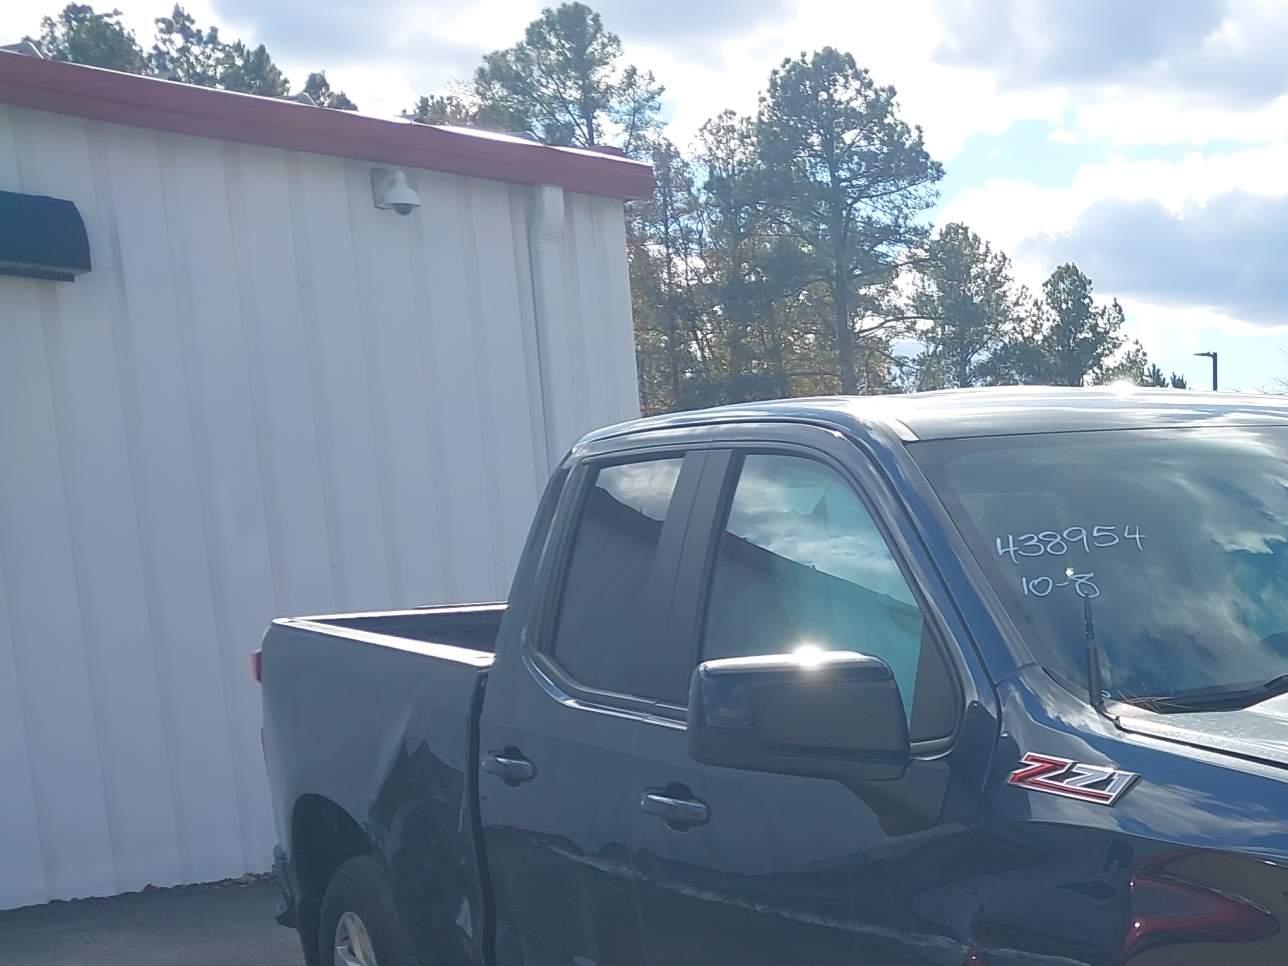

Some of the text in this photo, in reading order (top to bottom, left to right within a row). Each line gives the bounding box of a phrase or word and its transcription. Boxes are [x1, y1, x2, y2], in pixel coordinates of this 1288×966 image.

[996, 524, 1146, 564] 438954
[1021, 572, 1100, 598] 10-8
[1008, 751, 1137, 805] Z71
